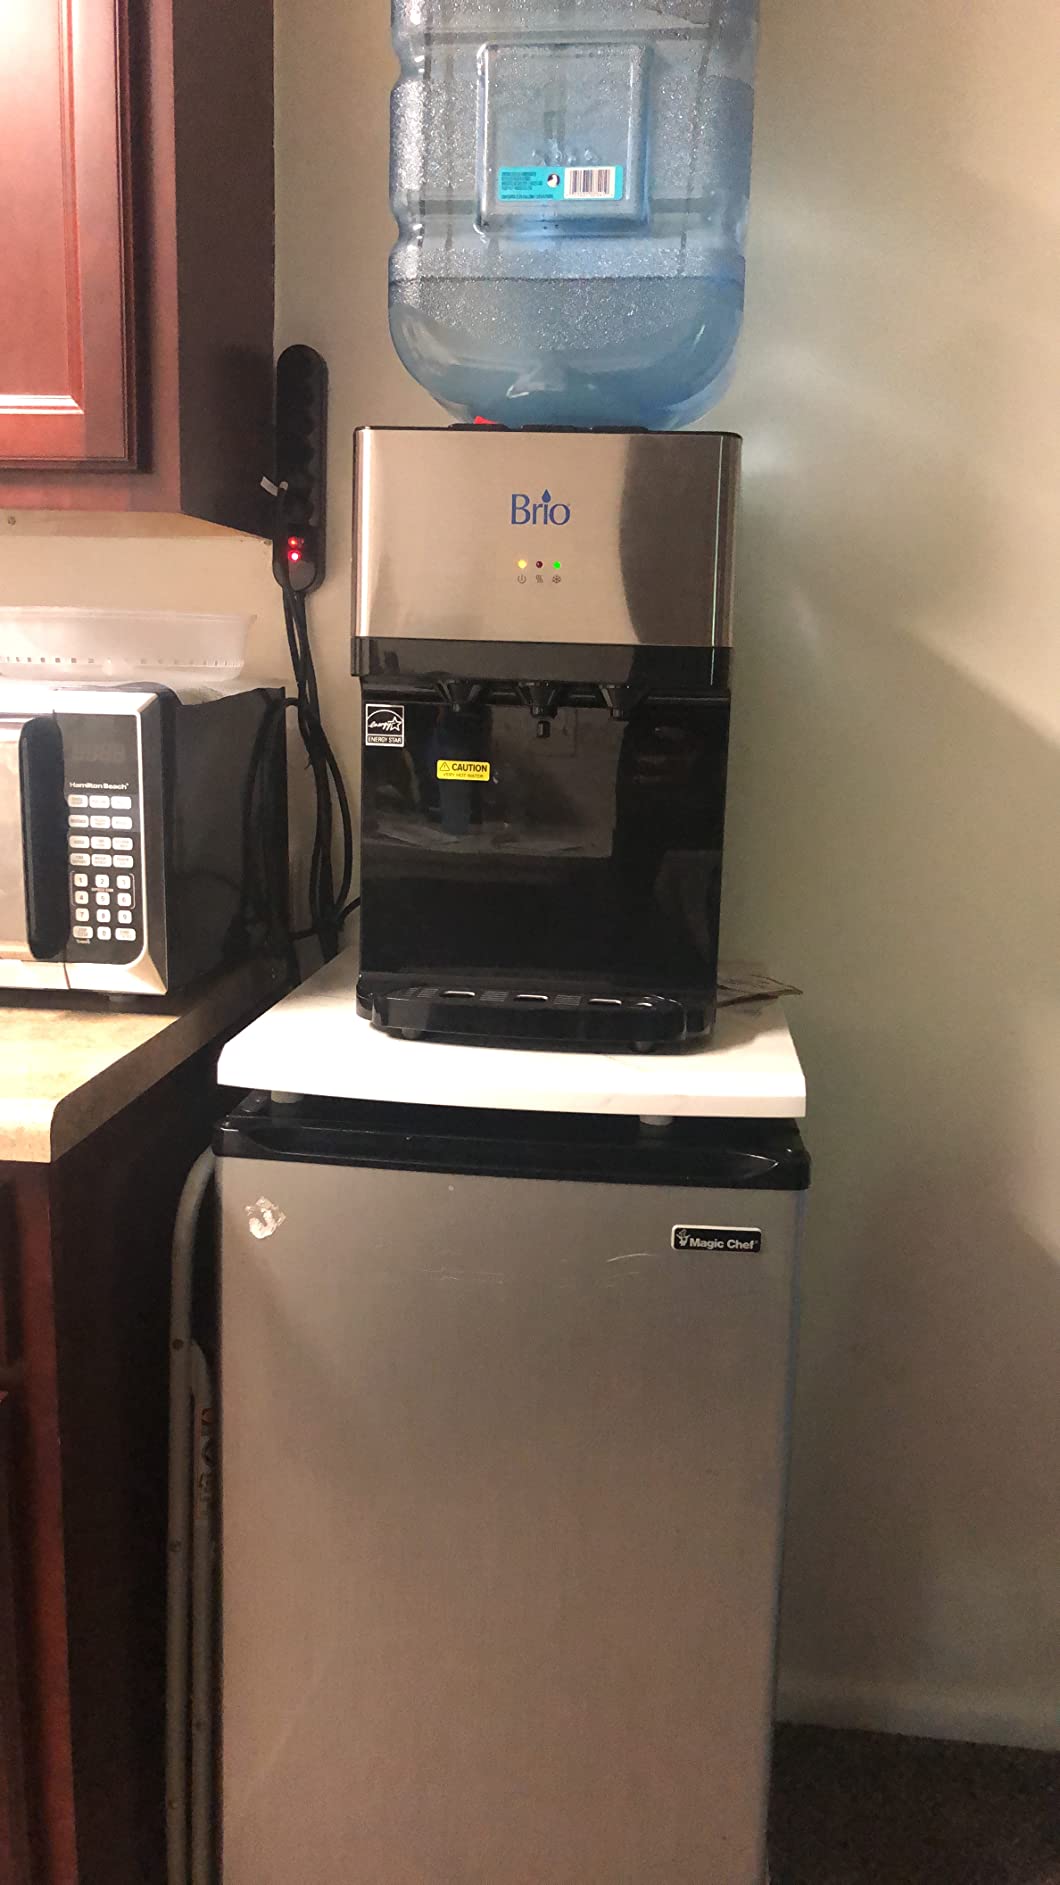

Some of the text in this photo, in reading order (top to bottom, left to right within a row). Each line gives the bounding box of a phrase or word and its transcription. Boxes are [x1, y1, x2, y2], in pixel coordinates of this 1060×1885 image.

[511, 489, 571, 525] Brio
[451, 763, 488, 773] CAUTION
[689, 1237, 755, 1250] Magic Chef
